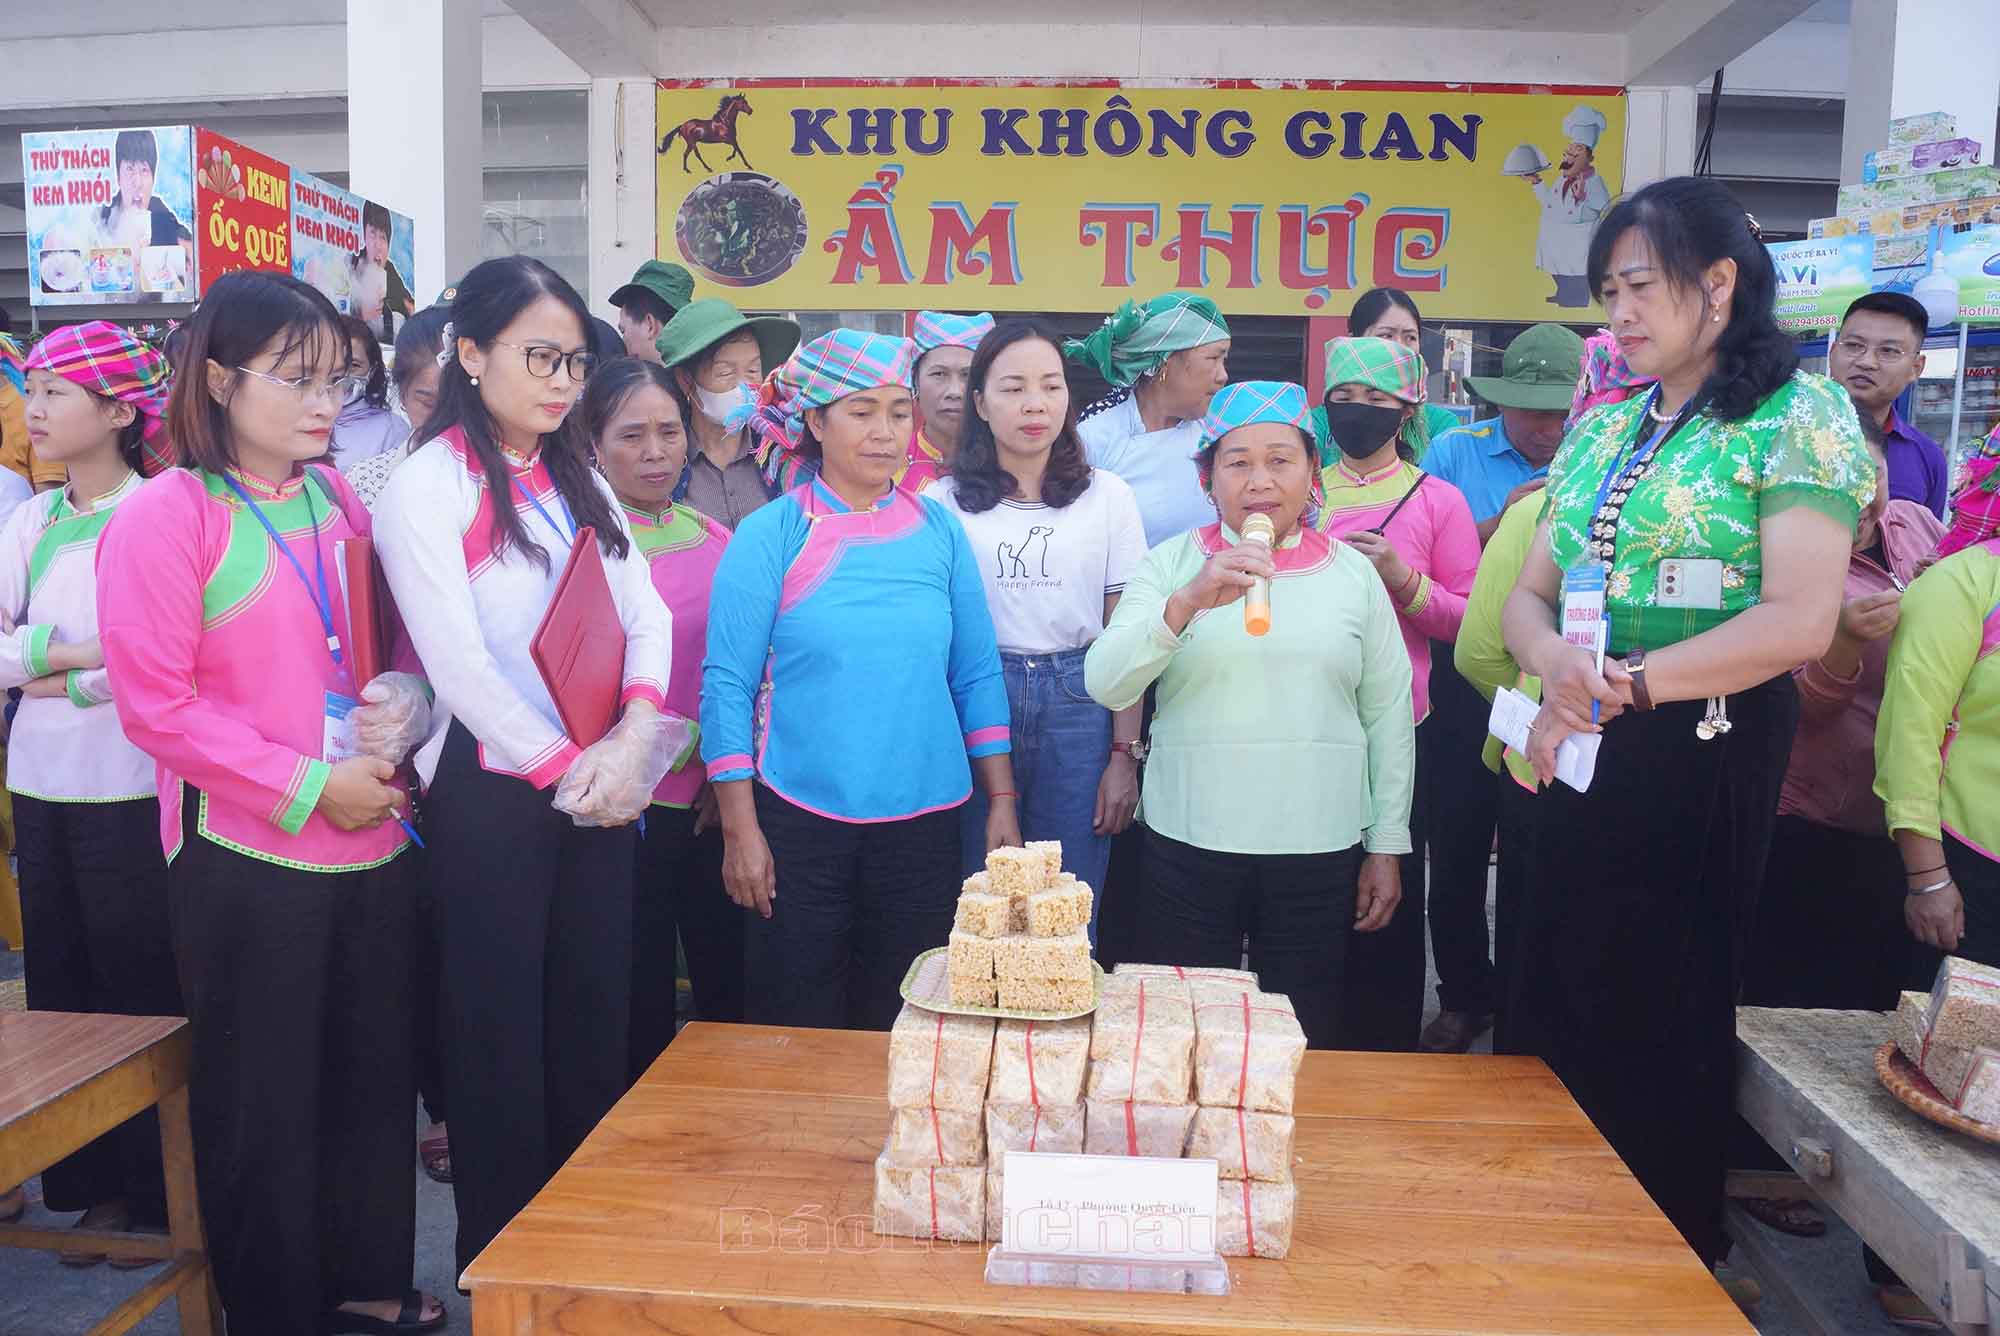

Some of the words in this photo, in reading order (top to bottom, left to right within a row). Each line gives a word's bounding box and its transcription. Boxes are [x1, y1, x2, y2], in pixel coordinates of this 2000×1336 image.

[789, 108, 955, 157] KHU
[980, 95, 1257, 159] KHÔNG
[1284, 110, 1483, 162] GIAN
[61, 144, 110, 170] THÁCH
[33, 186, 64, 206] KEM
[67, 172, 111, 205] KHÓI
[247, 166, 287, 210] KEM
[321, 194, 360, 225] THÁCH
[209, 199, 240, 252] ỐC
[245, 221, 288, 267] QUẾ
[296, 214, 323, 243] KEM
[325, 220, 360, 254] KHÓI
[823, 163, 1024, 285] ẨM
[1080, 192, 1450, 309] THỰC
